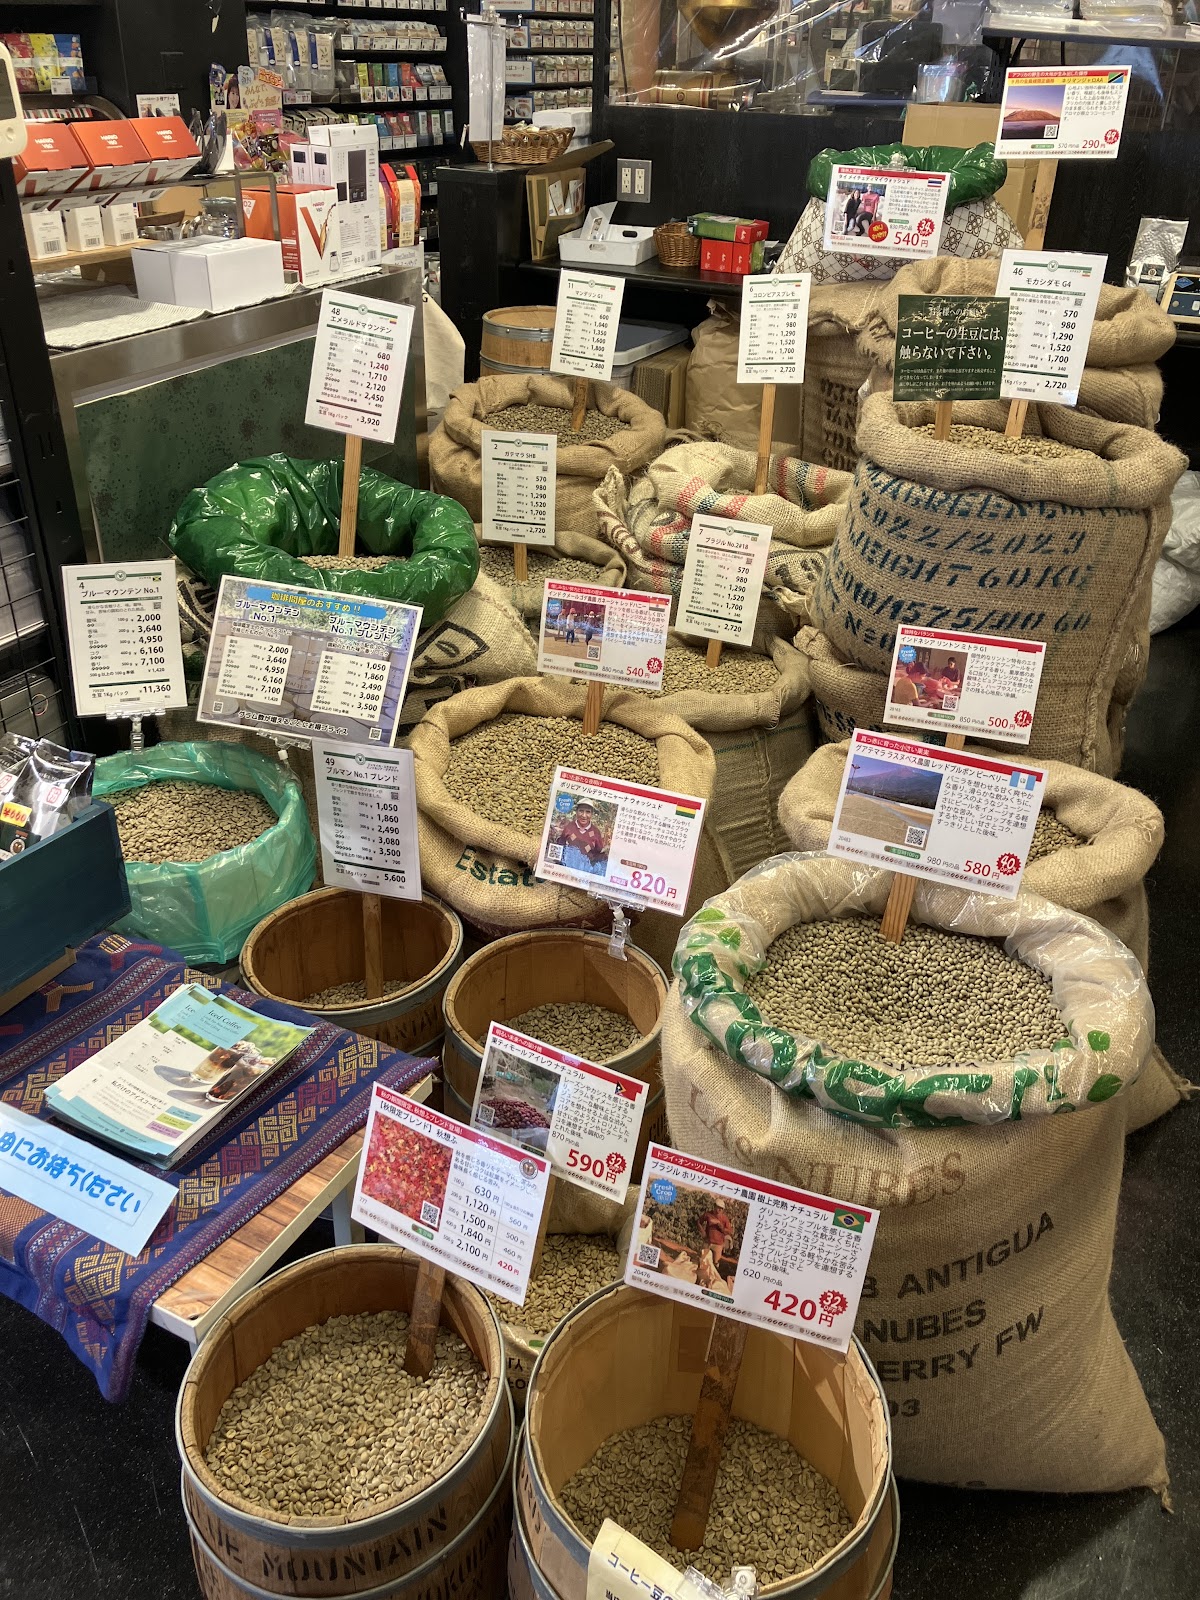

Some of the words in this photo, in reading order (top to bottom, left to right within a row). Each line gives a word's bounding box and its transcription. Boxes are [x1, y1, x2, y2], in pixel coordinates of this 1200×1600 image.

[1082, 140, 1100, 148] 290
[894, 232, 919, 246] 540
[1013, 268, 1023, 276] 46
[331, 307, 340, 315] 48
[1063, 310, 1078, 318] 570
[330, 316, 392, 334] エメラルドマウンテン
[902, 327, 1004, 340] コーヒーの生豆には、
[1052, 332, 1074, 341] 1,290
[377, 352, 390, 360] 680
[900, 345, 991, 360] 触らないで下さい。
[1047, 354, 1069, 363] 1,700
[366, 382, 386, 392] 2,120
[1044, 380, 1066, 389] 2,720
[364, 392, 384, 402] 2,450
[360, 416, 380, 426] 3,920
[705, 537, 725, 545] ブラジル
[81, 587, 142, 598] ブルーマウンテン
[729, 584, 746, 592] 1,290
[235, 599, 300, 617] ブルーマウンテン
[137, 614, 161, 622] 2,000
[253, 611, 276, 624] No.1
[137, 625, 162, 633] 3,640
[329, 616, 396, 635] ブルーマウンテン
[724, 624, 741, 632] 2,720
[139, 636, 162, 644] 4,950
[331, 625, 353, 635] No.1
[356, 629, 392, 642] ブレンド
[268, 645, 289, 655] 2,000
[901, 636, 935, 645] インドネシア
[937, 640, 960, 649] リントン
[961, 643, 979, 651] ミトラ
[140, 657, 165, 666] 7,100
[366, 662, 386, 671] 1,050
[626, 666, 644, 677] 540
[143, 684, 171, 693] 11,360
[260, 685, 281, 695] 7,100
[356, 702, 378, 712] 3,500
[988, 717, 1008, 729] 500
[860, 735, 930, 757] 真っ赤に育った小さい果実
[325, 758, 335, 766] 49
[855, 744, 886, 757] グアテマラ
[931, 761, 975, 777] レッドブルボン
[327, 767, 352, 776] ブルマン
[354, 771, 368, 779] No.1
[371, 773, 398, 783] ブレンド
[946, 775, 1034, 800] バニラを想わせる甘く爽やか
[376, 802, 398, 812] 1,050
[629, 796, 663, 810] ウォッシュド
[943, 789, 1030, 814] シトラスのようなジューシー
[377, 825, 400, 835] 2,490
[379, 848, 401, 857] 3,500
[926, 856, 942, 866] 980
[943, 860, 960, 870] 円の品
[1002, 855, 1016, 869] 40
[963, 860, 991, 877] 580
[992, 872, 1000, 880] 円
[384, 874, 406, 883] 5,600
[630, 871, 666, 895] 820
[667, 887, 677, 898] 円
[208, 1009, 222, 1021] Iced
[222, 1017, 241, 1030] Coffee
[527, 1050, 553, 1067] アイレウ
[553, 1062, 586, 1081] ナチュラル
[380, 1100, 433, 1134] 【秋限定ブレンド】
[436, 1129, 458, 1146] 秋想ふ
[551, 1131, 565, 1141] 870
[566, 1148, 604, 1178] 590
[606, 1172, 616, 1184] 円
[608, 1154, 622, 1166] 32
[474, 1184, 492, 1199] 630
[651, 1160, 681, 1176] ブラジル
[682, 1172, 757, 1201] ホリゾンティーナ農園
[757, 1193, 788, 1211] 樹上完熟
[790, 1203, 829, 1221] ナチュラル
[654, 1183, 674, 1191] Fresh
[465, 1195, 489, 1214] 1,120
[462, 1210, 486, 1229] 1,500
[509, 1216, 522, 1228] 560
[759, 1207, 862, 1242] グリーンアップルを感じる香
[459, 1224, 483, 1242] 1,840
[756, 1222, 857, 1257] カシスのようなジューシーさ
[456, 1238, 481, 1258] 2,100
[753, 1236, 858, 1273] をイメージする軽やかな苦み。
[751, 1251, 804, 1272] やさしい甘さと
[752, 1244, 853, 1278] メイプルシロップを連想する
[896, 1211, 1056, 1300] ANTIGUA
[497, 1260, 513, 1273] 420
[749, 1258, 790, 1276] コクの後味。
[742, 1268, 761, 1280] 620
[763, 1275, 783, 1287] 円の品
[823, 1292, 842, 1308] 32
[763, 1289, 817, 1321] 420
[818, 1313, 834, 1328] 円
[863, 1300, 988, 1345] NUBES
[877, 1344, 980, 1383] ERRY
[995, 1307, 1044, 1353] FW
[262, 1506, 448, 1582] MOUNTAIN
